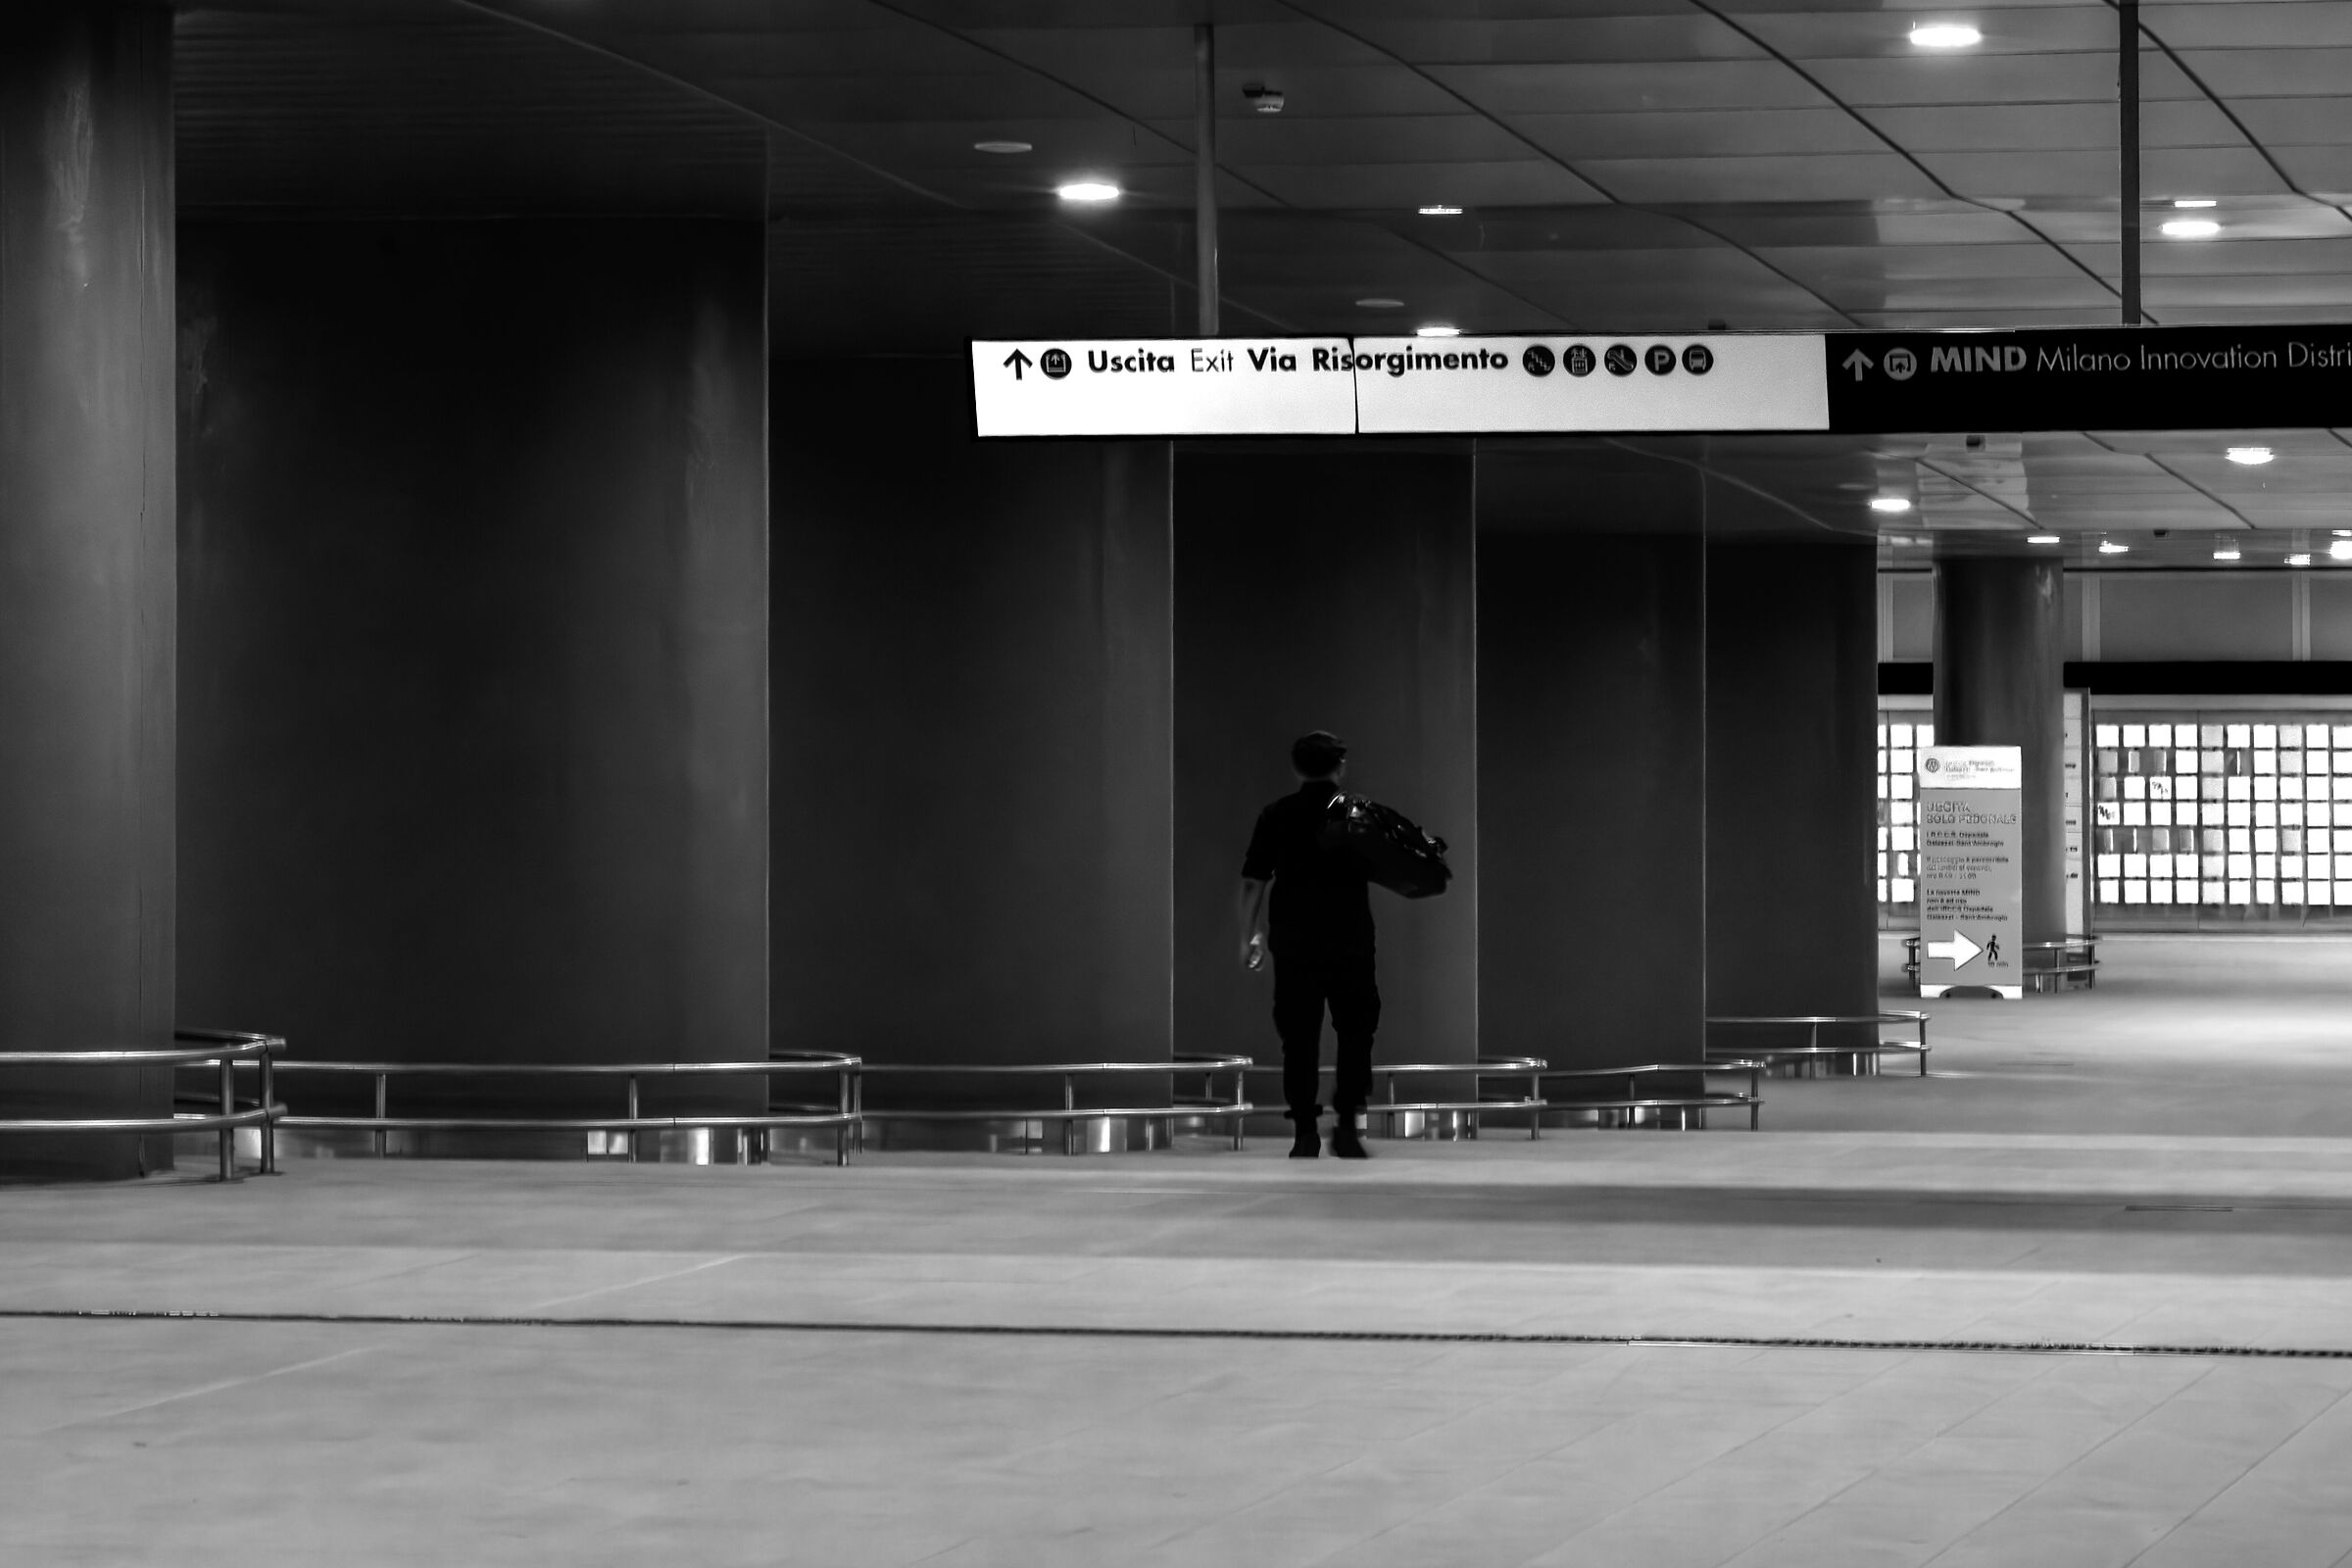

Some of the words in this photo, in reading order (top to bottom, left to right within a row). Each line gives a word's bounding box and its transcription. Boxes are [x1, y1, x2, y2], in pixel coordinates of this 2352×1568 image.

[1088, 347, 1175, 373] Uscita
[1191, 348, 1234, 373] Exit
[1247, 347, 1297, 372] Via
[1312, 345, 1509, 376] Risorgimento
[1930, 346, 2028, 372] MIND
[2036, 343, 2131, 372] Milano
[2140, 342, 2278, 369] Innovation
[2288, 341, 2351, 368] Distri
[1927, 813, 1956, 824] SOLO
